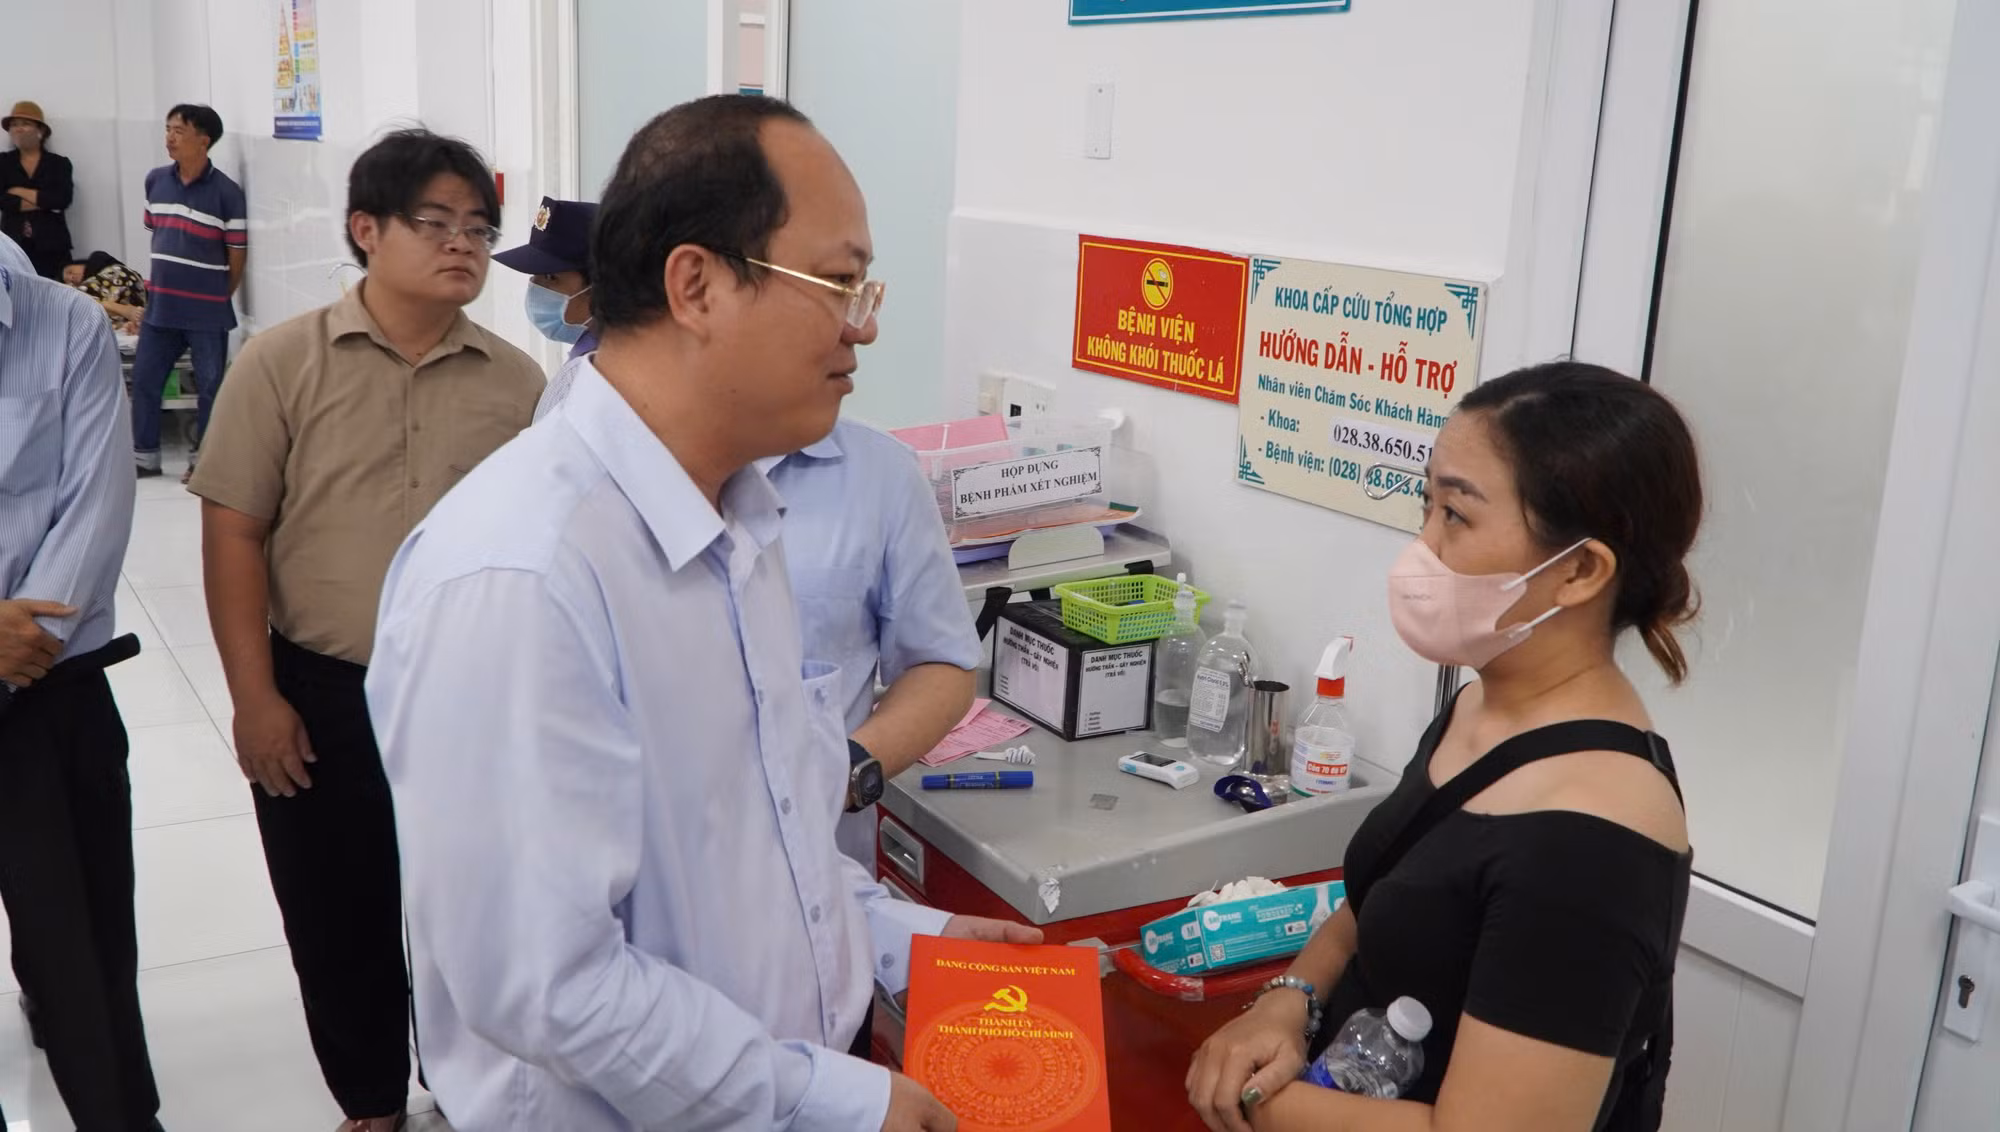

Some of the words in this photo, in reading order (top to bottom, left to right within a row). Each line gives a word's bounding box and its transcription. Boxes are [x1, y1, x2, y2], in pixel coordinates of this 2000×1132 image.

[1118, 306, 1156, 336] BỆNH
[1160, 314, 1195, 345] VIỆN
[1274, 286, 1309, 312] KHOA
[1312, 285, 1340, 316] CẤP
[1342, 292, 1370, 321] CỨU
[1375, 290, 1412, 328] TỔNG
[1416, 306, 1448, 336] HỢP
[1087, 334, 1126, 363] KHÔNG
[1129, 342, 1159, 370] KHÓI
[1162, 348, 1204, 380] THUỐC
[1208, 356, 1224, 384] LÁ
[1259, 328, 1320, 368] HƯỚNG
[1324, 331, 1363, 376] DẪN
[1380, 341, 1409, 385] HỖ
[1415, 358, 1458, 399] TRỢ
[1258, 374, 1285, 394] Nhân
[1289, 381, 1311, 400] viên
[1314, 385, 1346, 408] Chăm
[1350, 392, 1371, 412] Sóc
[1375, 397, 1413, 422] Khách
[1268, 409, 1300, 432] Khoa:
[1001, 466, 1024, 478] HỘP
[1028, 460, 1059, 474] ĐỰNG
[1266, 440, 1294, 464] Bệnh
[1298, 450, 1324, 474] viện:
[1328, 456, 1361, 484] (028)
[960, 490, 991, 504] BỆNH
[1030, 479, 1051, 492] XÉT
[1054, 472, 1097, 488] NGHIỆM
[1010, 626, 1024, 640] DANH
[1037, 640, 1055, 656] THUỐC
[1091, 655, 1106, 664] DANH
[1108, 653, 1122, 662] MỤC
[1124, 649, 1143, 658] THUỐC
[1322, 766, 1329, 774] 70
[1050, 967, 1075, 976] NAM
[1043, 1030, 1073, 1040] MINH
